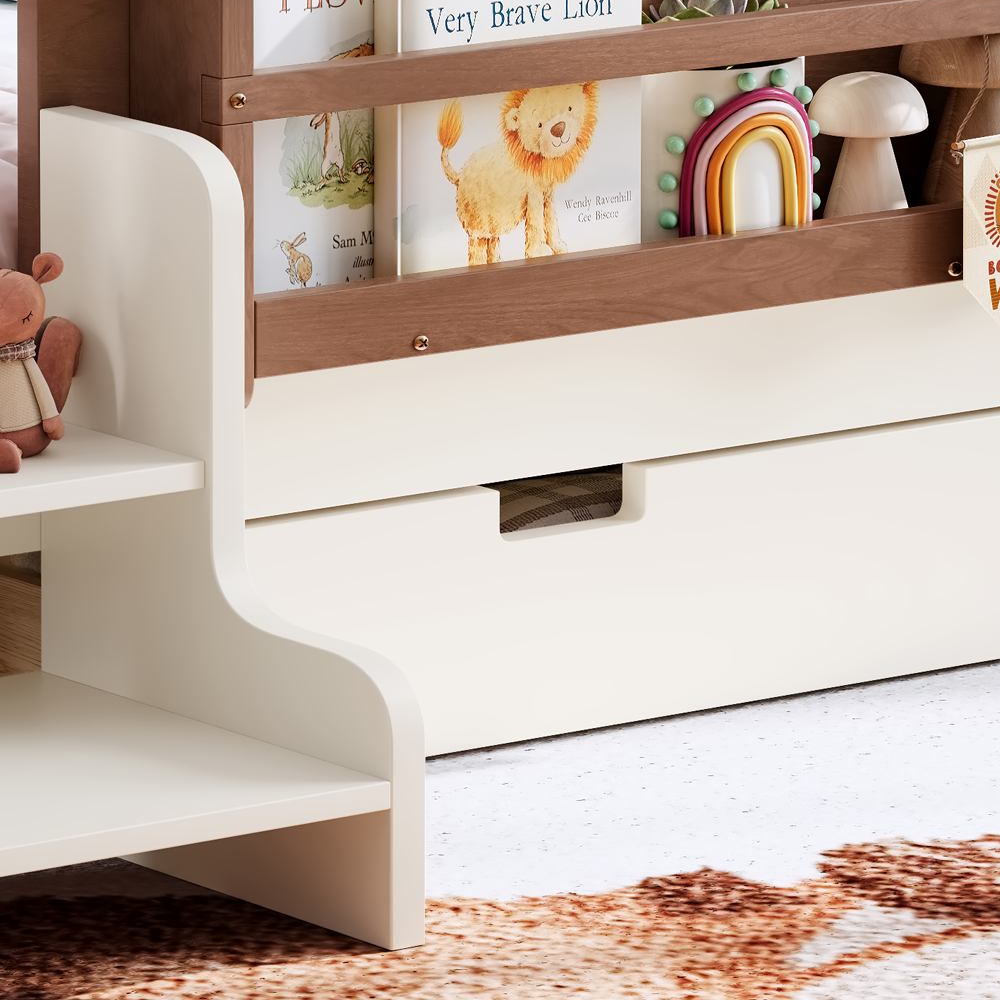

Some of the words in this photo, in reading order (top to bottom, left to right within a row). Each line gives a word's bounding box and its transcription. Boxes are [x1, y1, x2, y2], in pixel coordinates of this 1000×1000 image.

[426, 7, 479, 43] Very
[490, 0, 552, 29] Brave
[564, 196, 592, 211] Wendy
[595, 190, 632, 206] Ravenhill
[332, 234, 357, 249] Sam
